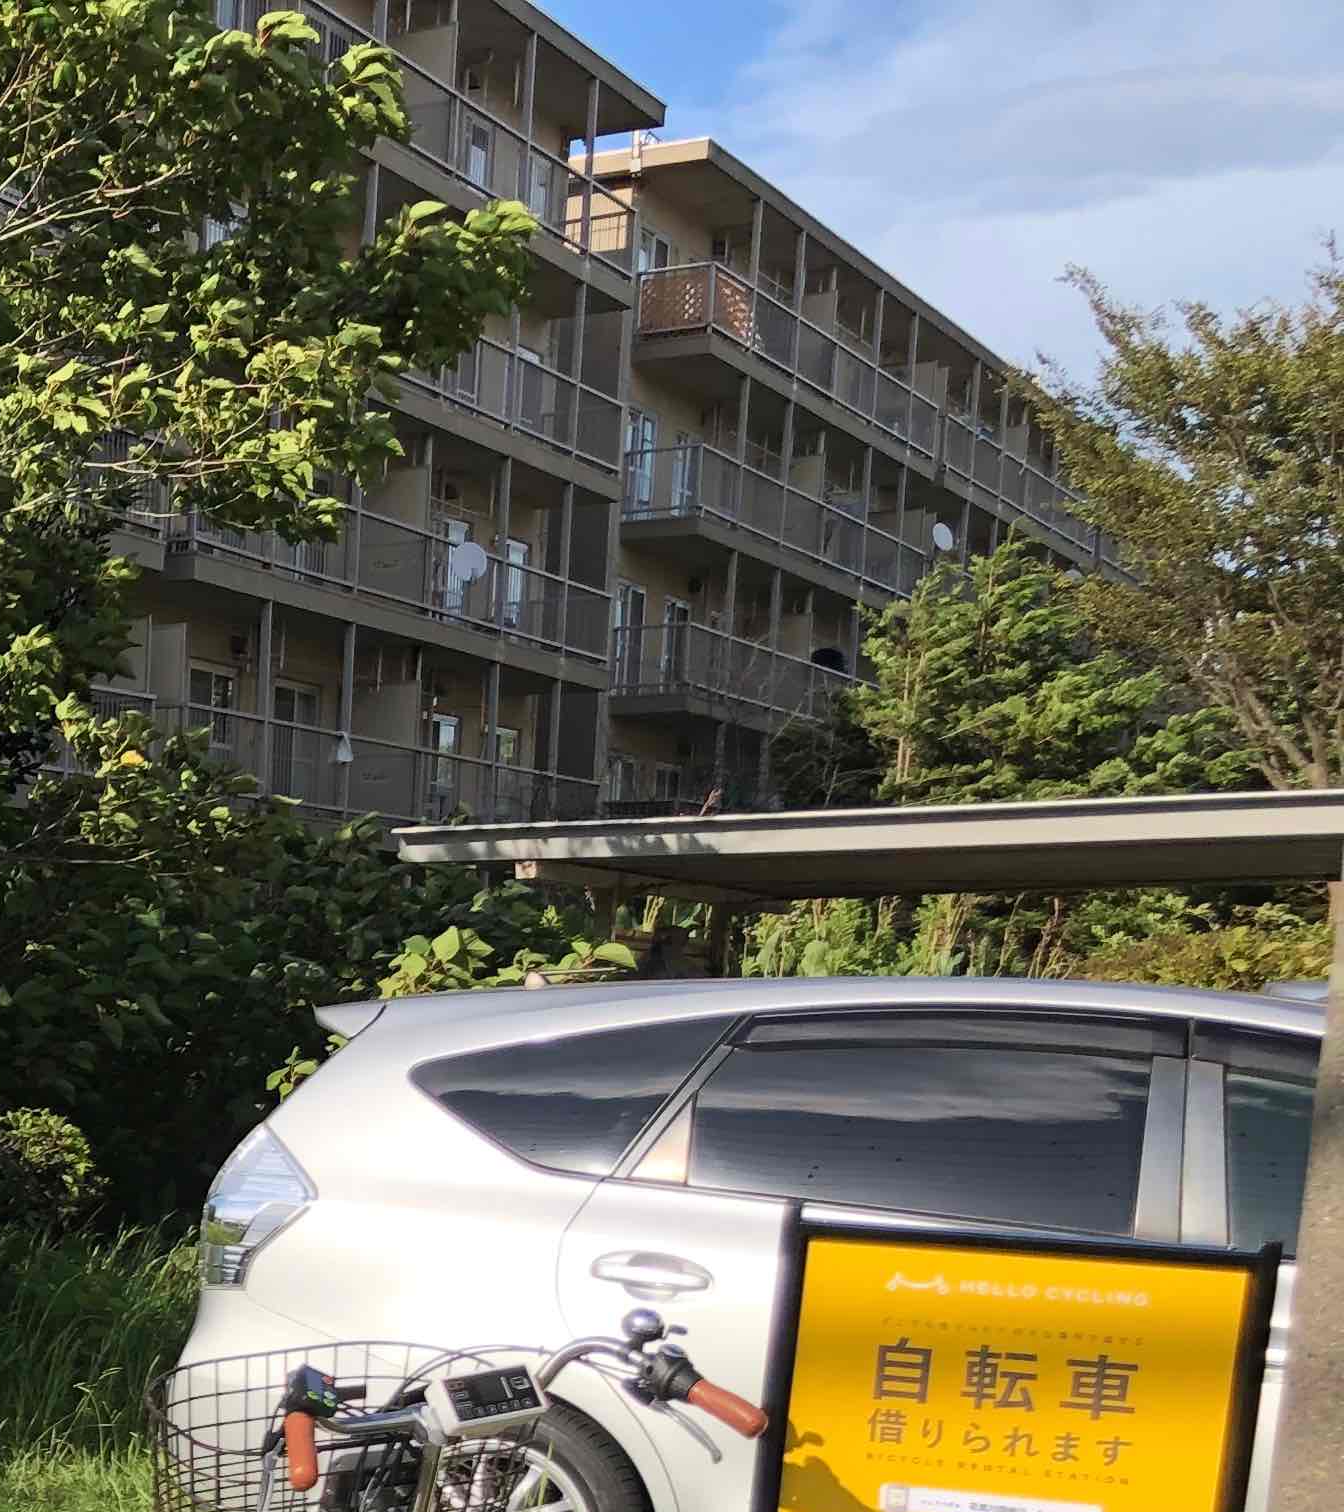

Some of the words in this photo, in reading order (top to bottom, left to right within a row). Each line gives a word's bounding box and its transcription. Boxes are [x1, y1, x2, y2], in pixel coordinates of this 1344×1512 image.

[959, 1279, 1038, 1298] HELLO
[1044, 1287, 1149, 1306] CYCLING
[872, 1335, 1139, 1421] 自転車
[867, 1407, 1133, 1466] 借りられます
